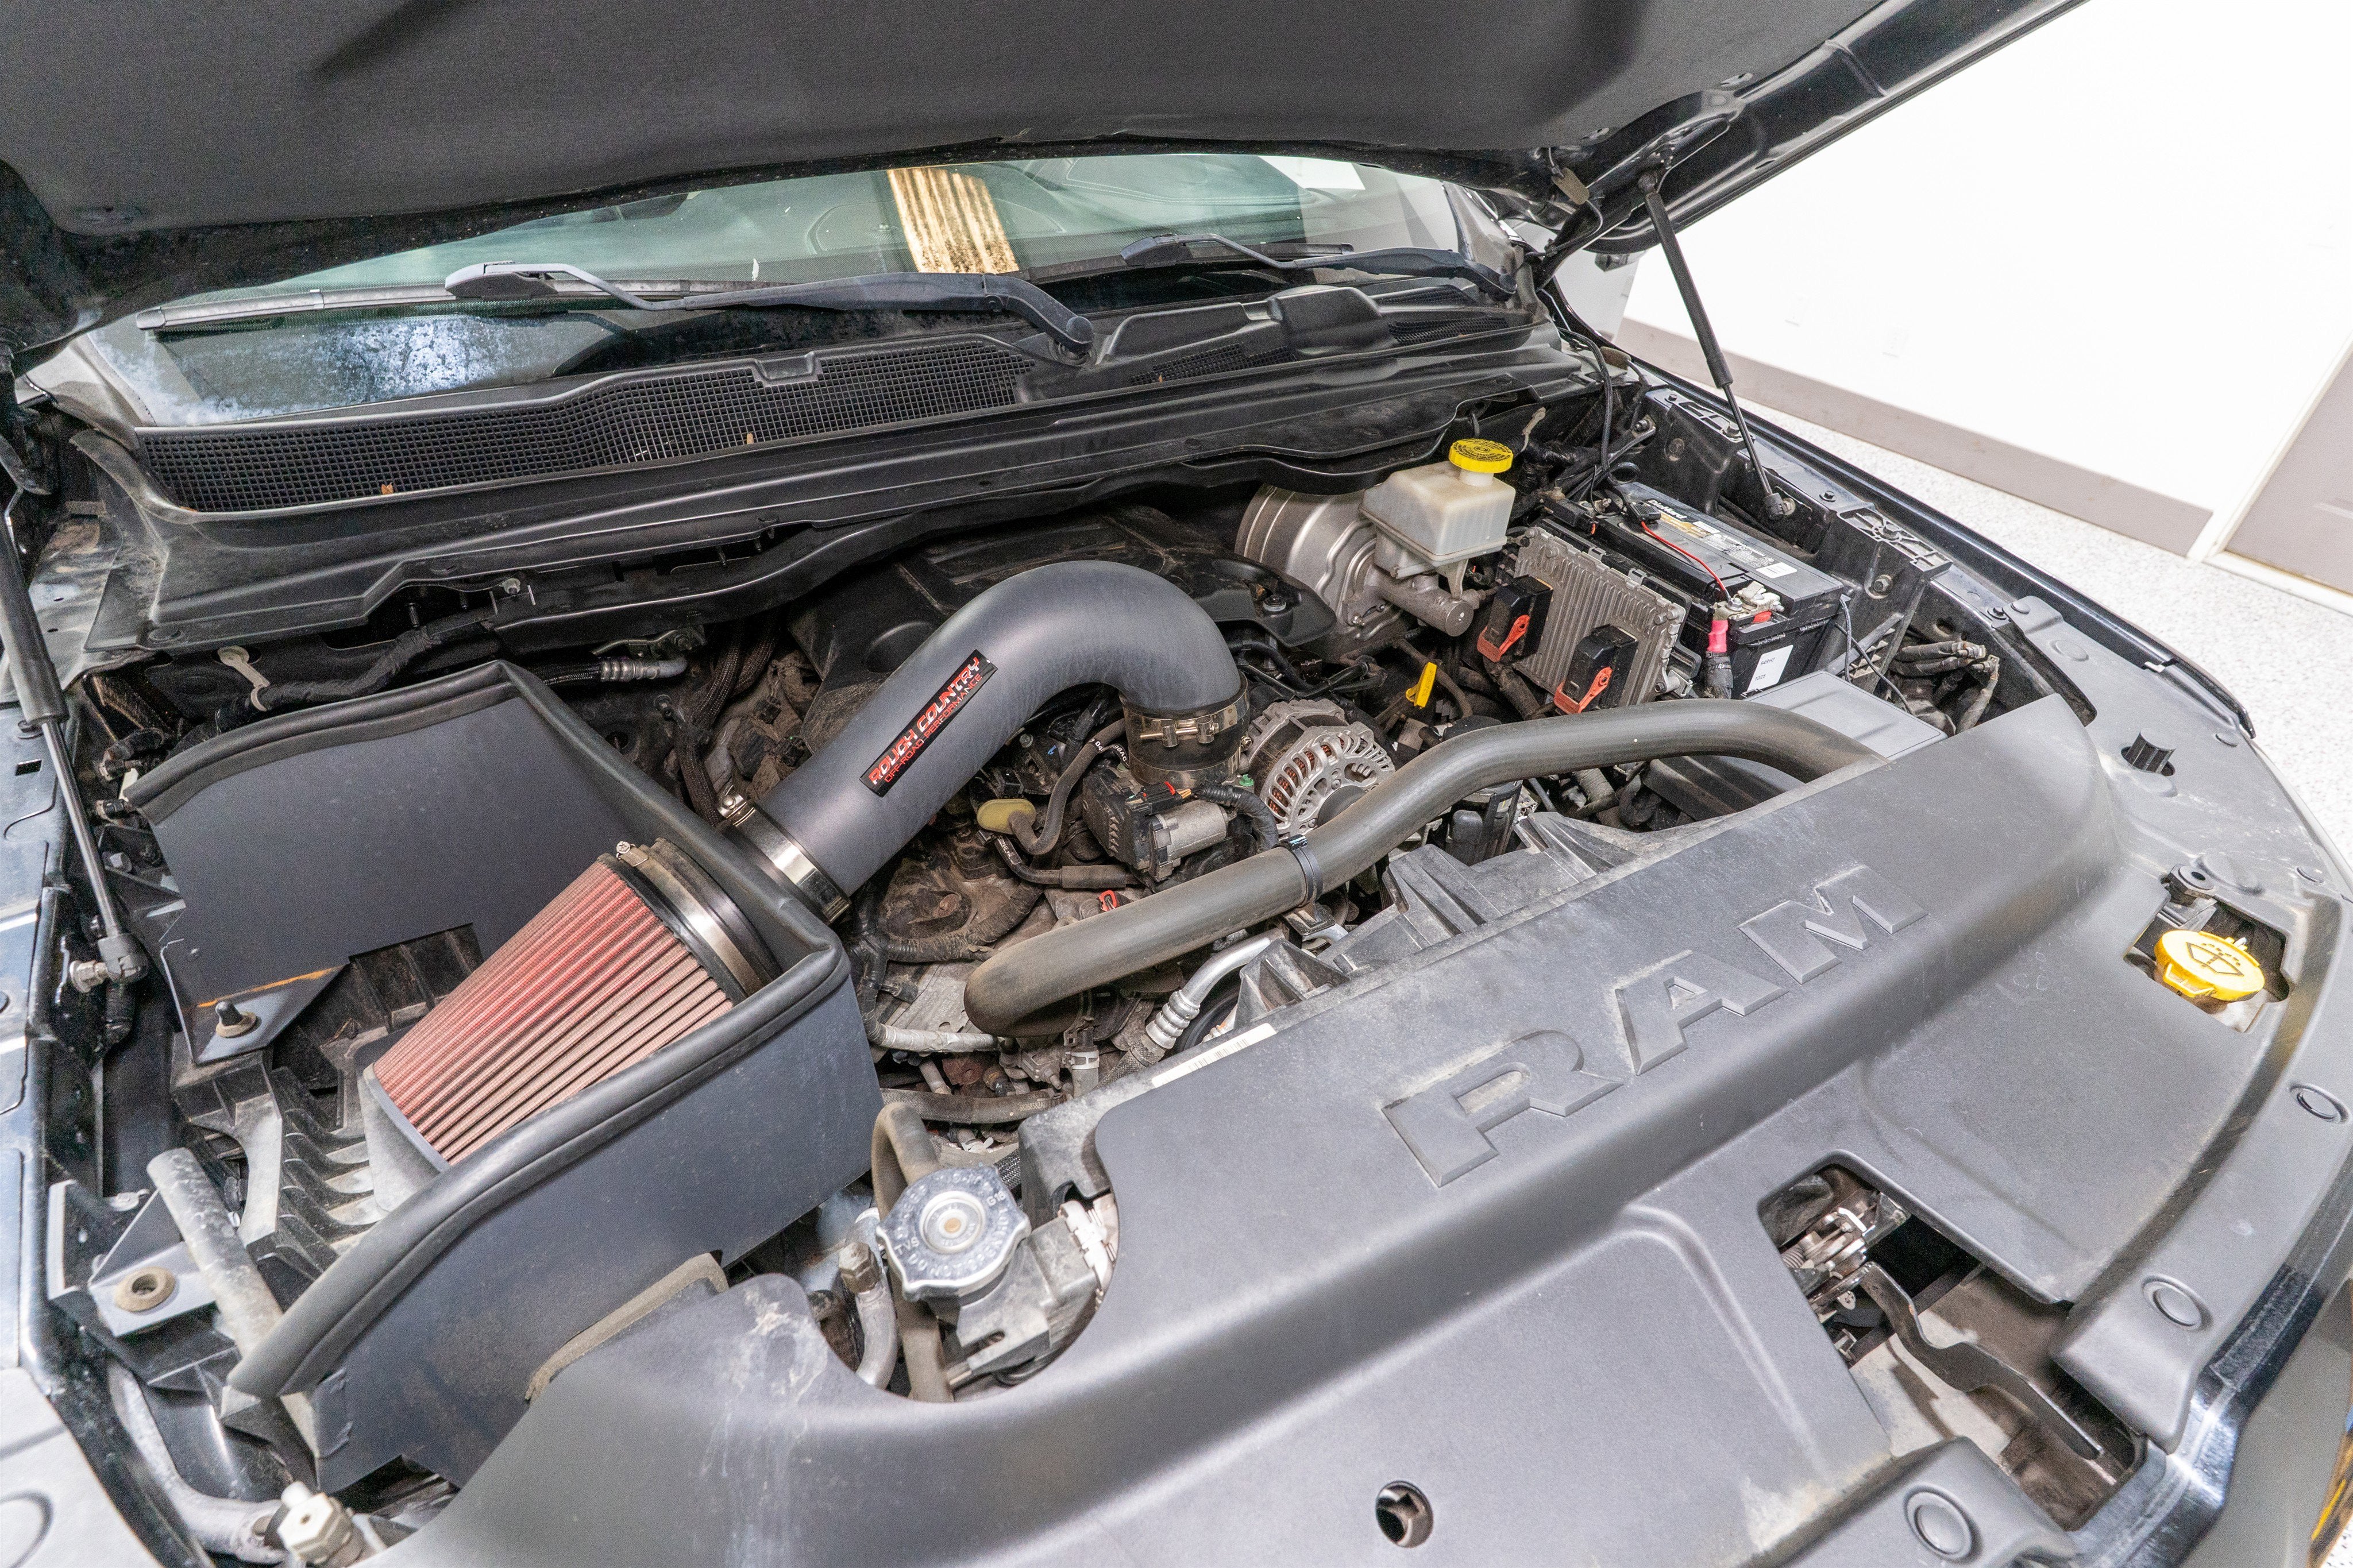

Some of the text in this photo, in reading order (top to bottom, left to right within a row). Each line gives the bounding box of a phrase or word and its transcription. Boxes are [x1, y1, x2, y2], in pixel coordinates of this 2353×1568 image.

[1647, 499, 1688, 519] DieHard
[869, 656, 980, 785] ROUGH COUNTRY
[884, 673, 983, 783] OFF-ROAD PERFORMANCE
[1113, 745, 1127, 762] 96AC
[1380, 864, 1930, 1188] RAM
[986, 1191, 1006, 1206] G18
[894, 1236, 920, 1256] TVS
